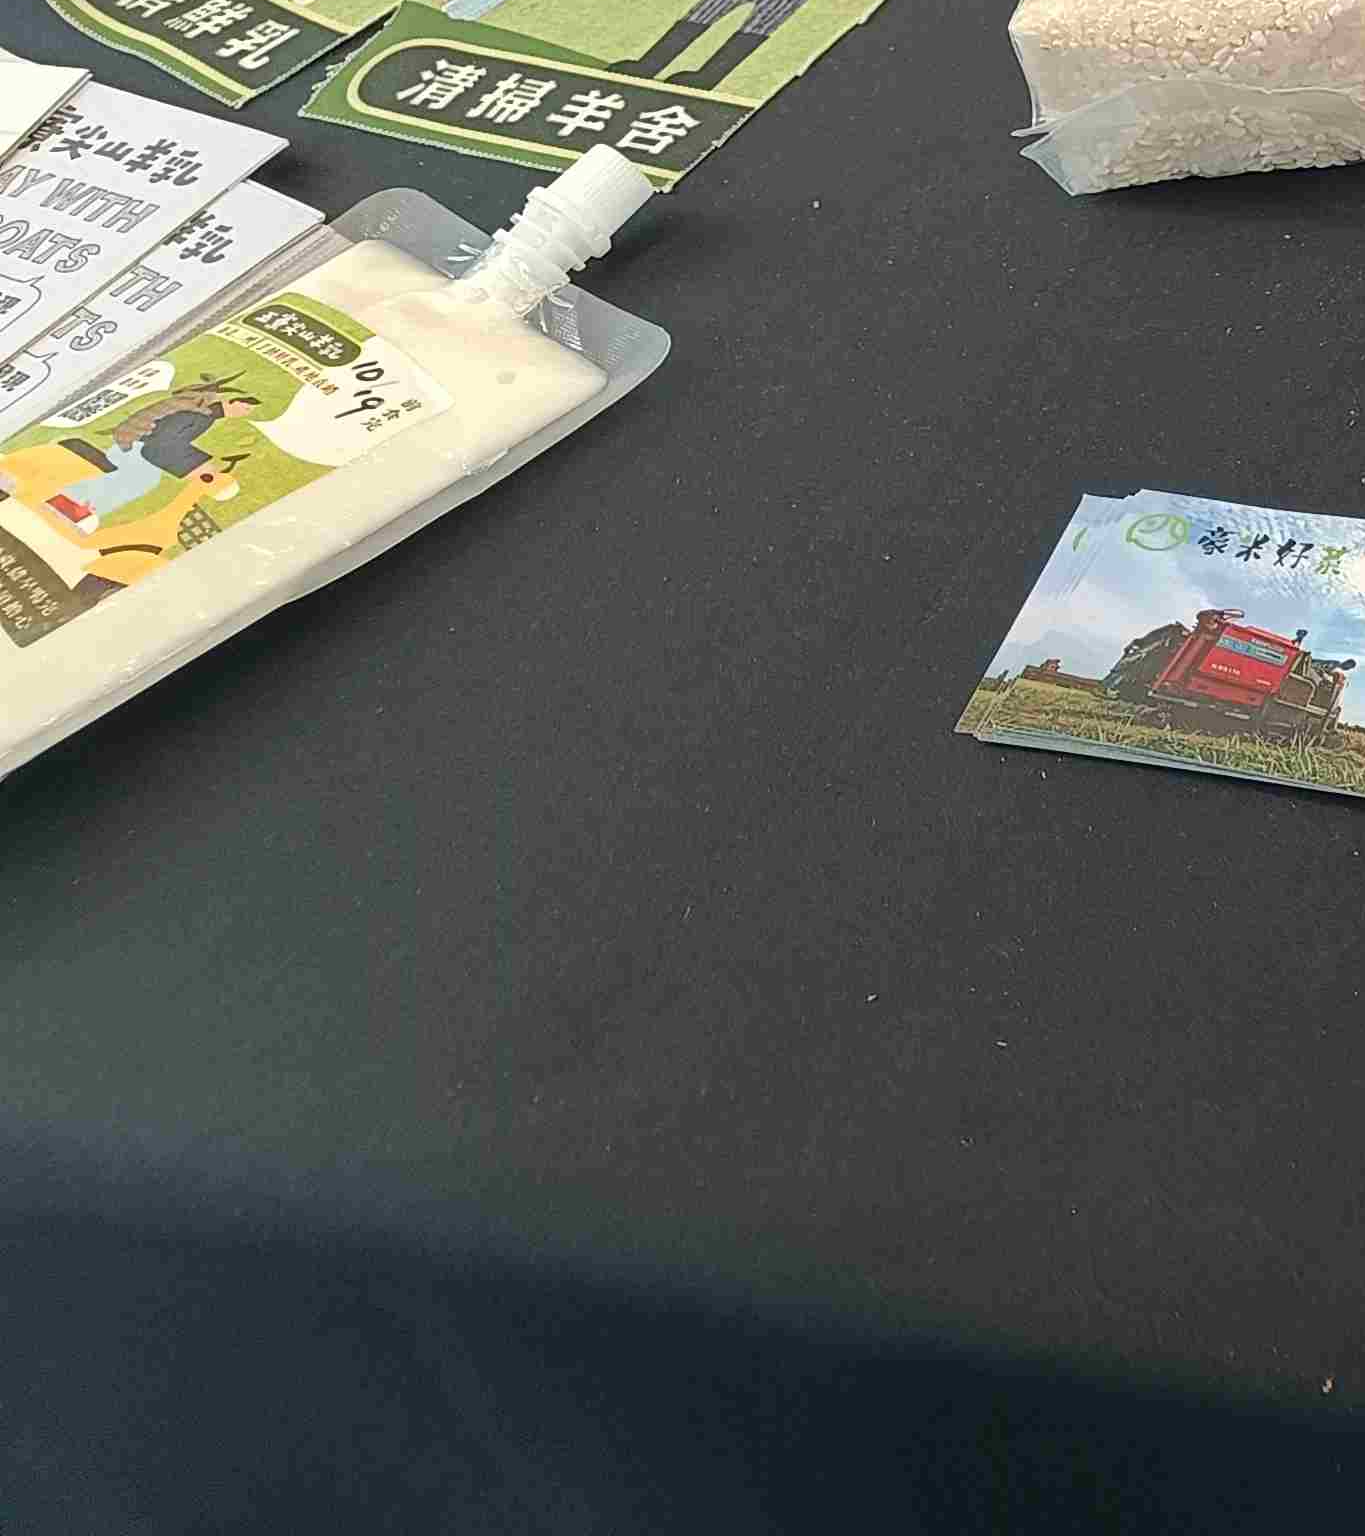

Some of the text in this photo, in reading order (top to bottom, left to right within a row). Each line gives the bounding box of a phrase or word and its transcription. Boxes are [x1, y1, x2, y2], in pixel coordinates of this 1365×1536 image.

[396, 58, 703, 158] 清掃羊舍
[40, 178, 161, 233] WITH
